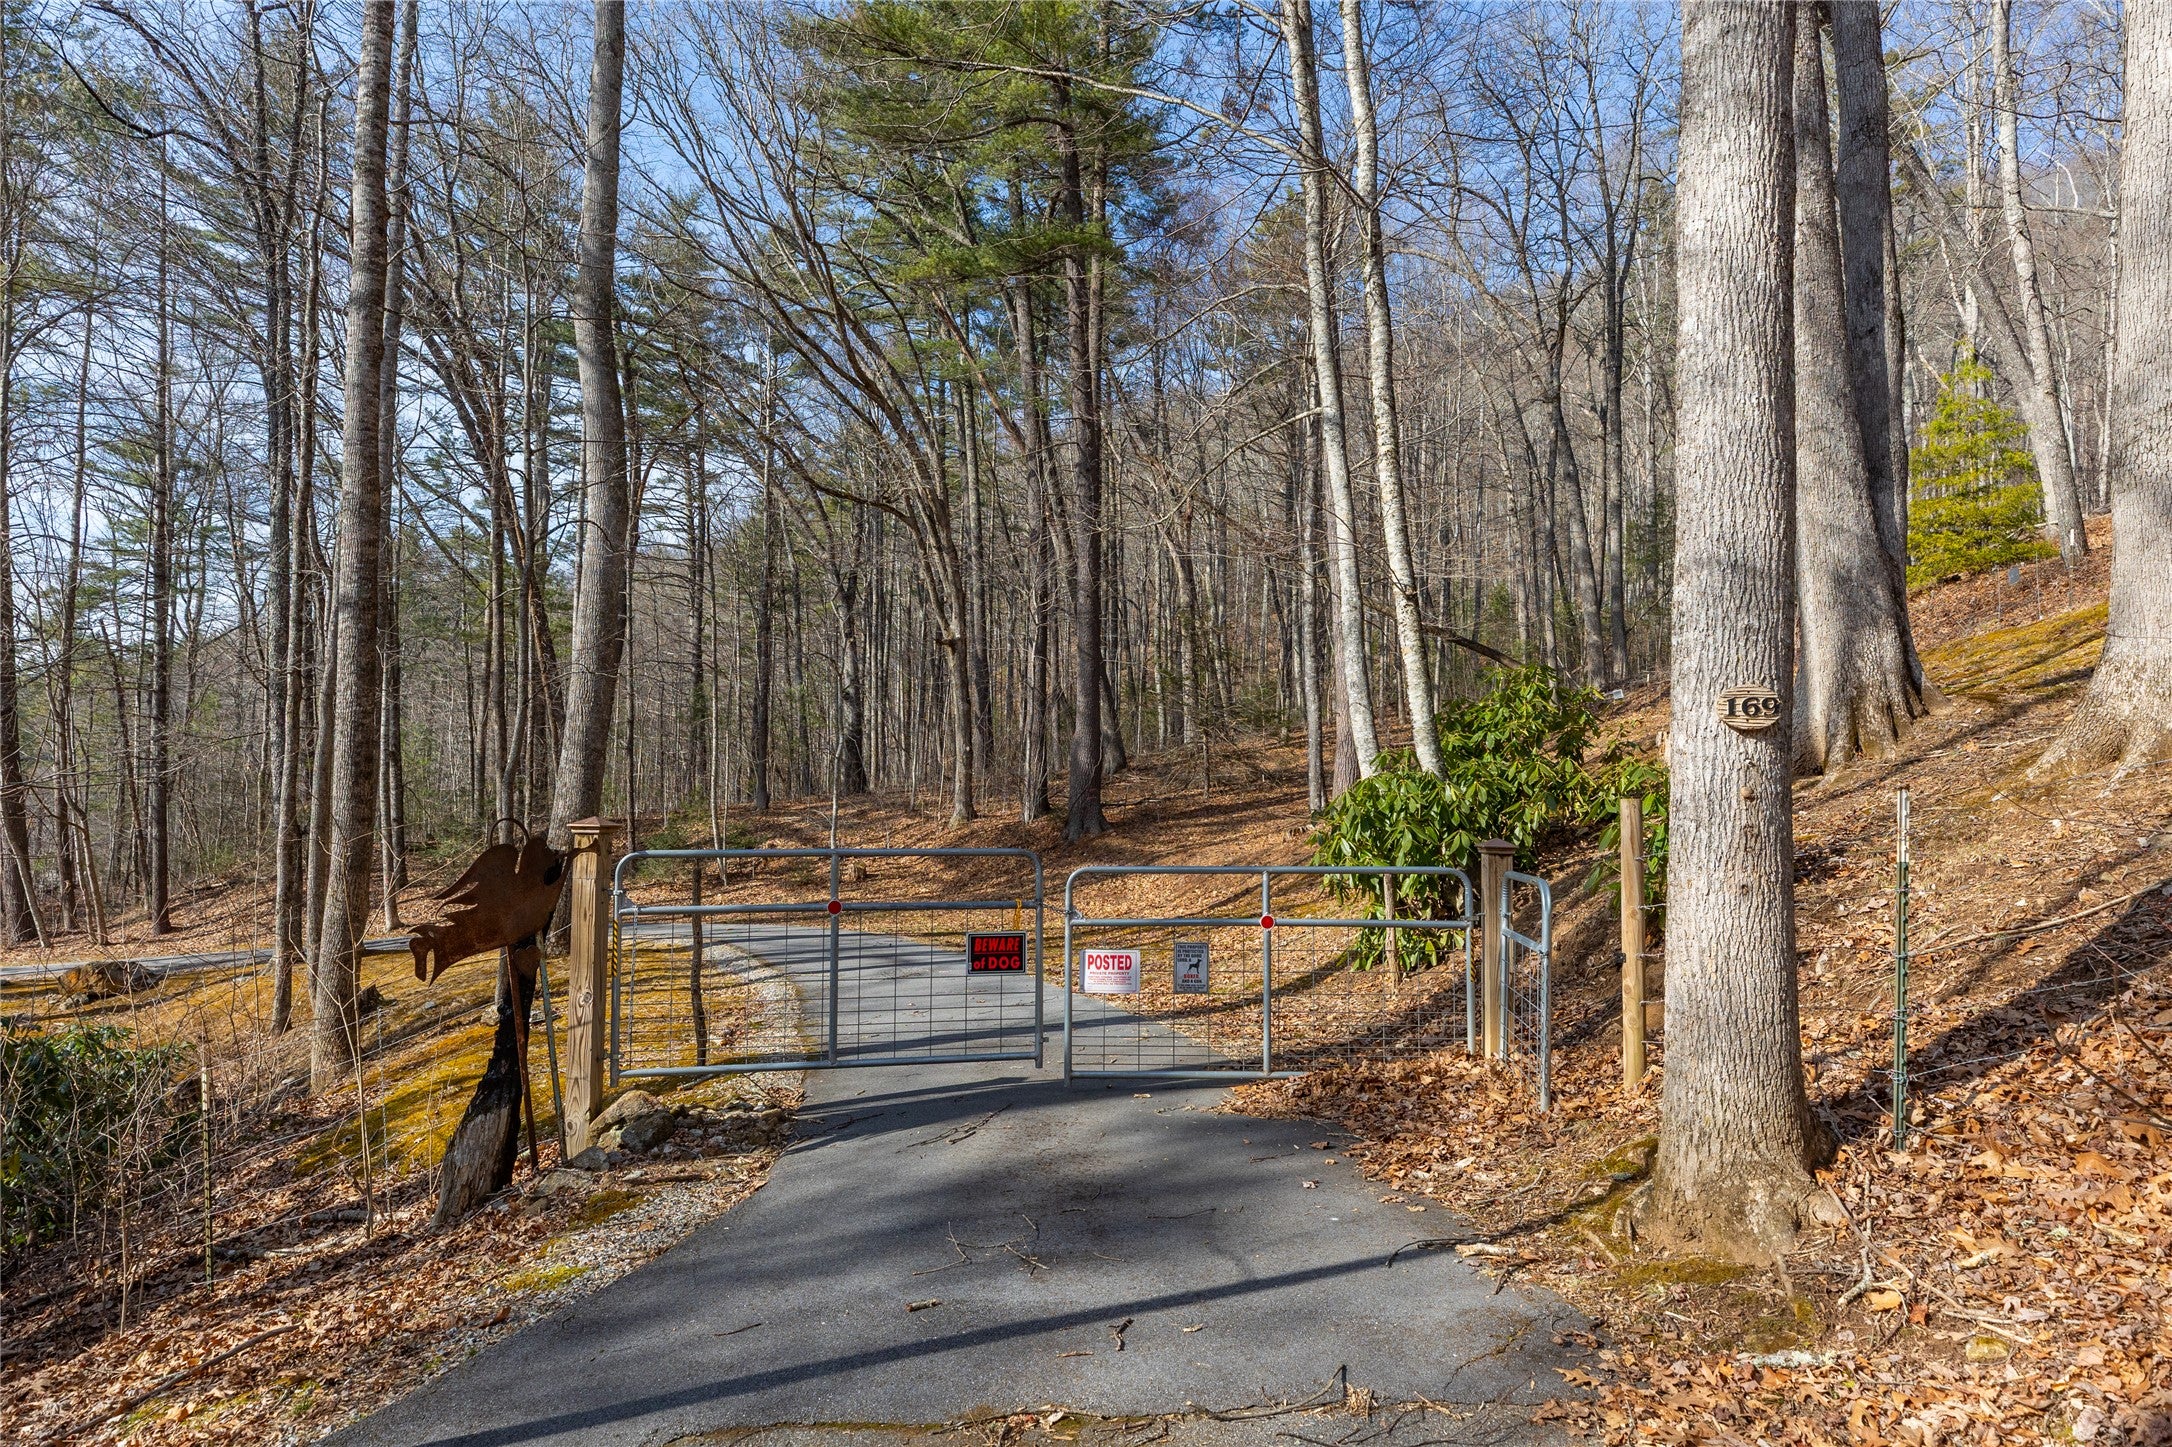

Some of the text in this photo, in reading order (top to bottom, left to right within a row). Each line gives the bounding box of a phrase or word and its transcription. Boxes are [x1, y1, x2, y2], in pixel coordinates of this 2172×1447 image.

[1726, 697, 1781, 718] 169
[974, 937, 1020, 951] BEWARE
[973, 956, 1020, 969] of DOG
[1087, 954, 1132, 970] POSTED
